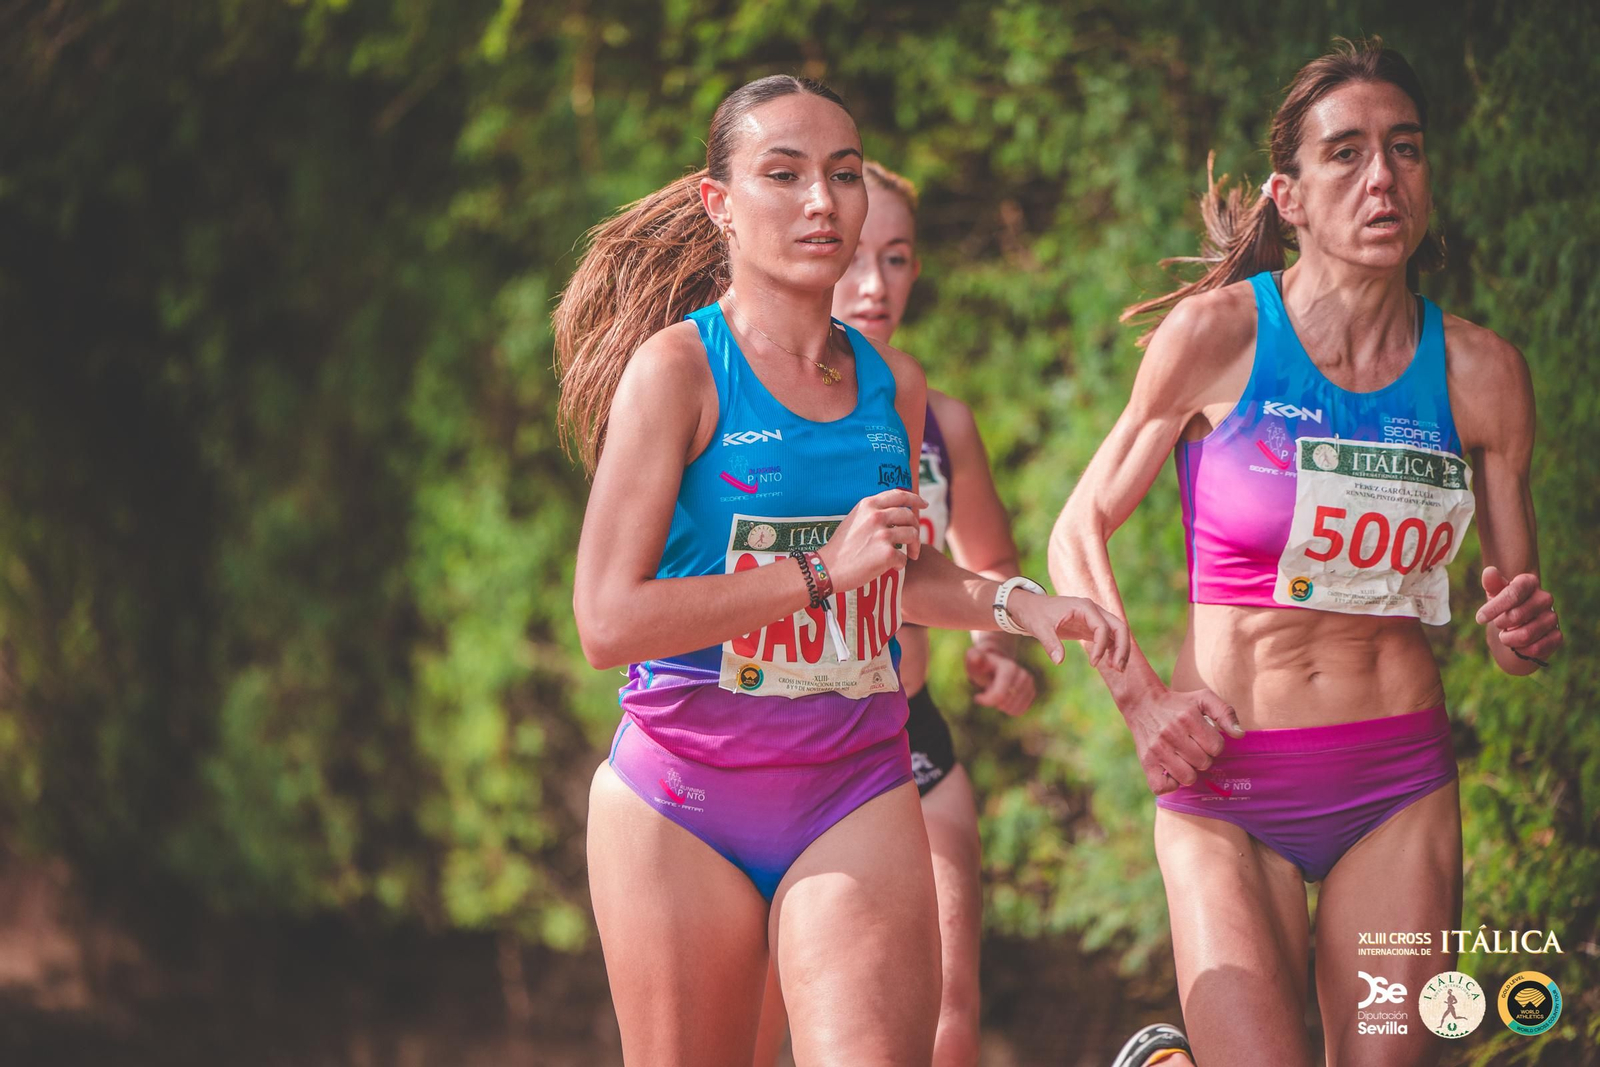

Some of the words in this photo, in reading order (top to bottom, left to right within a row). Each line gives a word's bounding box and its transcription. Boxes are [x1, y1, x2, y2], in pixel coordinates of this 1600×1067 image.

[1263, 400, 1322, 424] KON
[722, 429, 783, 447] KON
[1383, 425, 1441, 443] SEOANE
[1352, 450, 1435, 479] ITÁLICA
[1304, 505, 1454, 576] 5000
